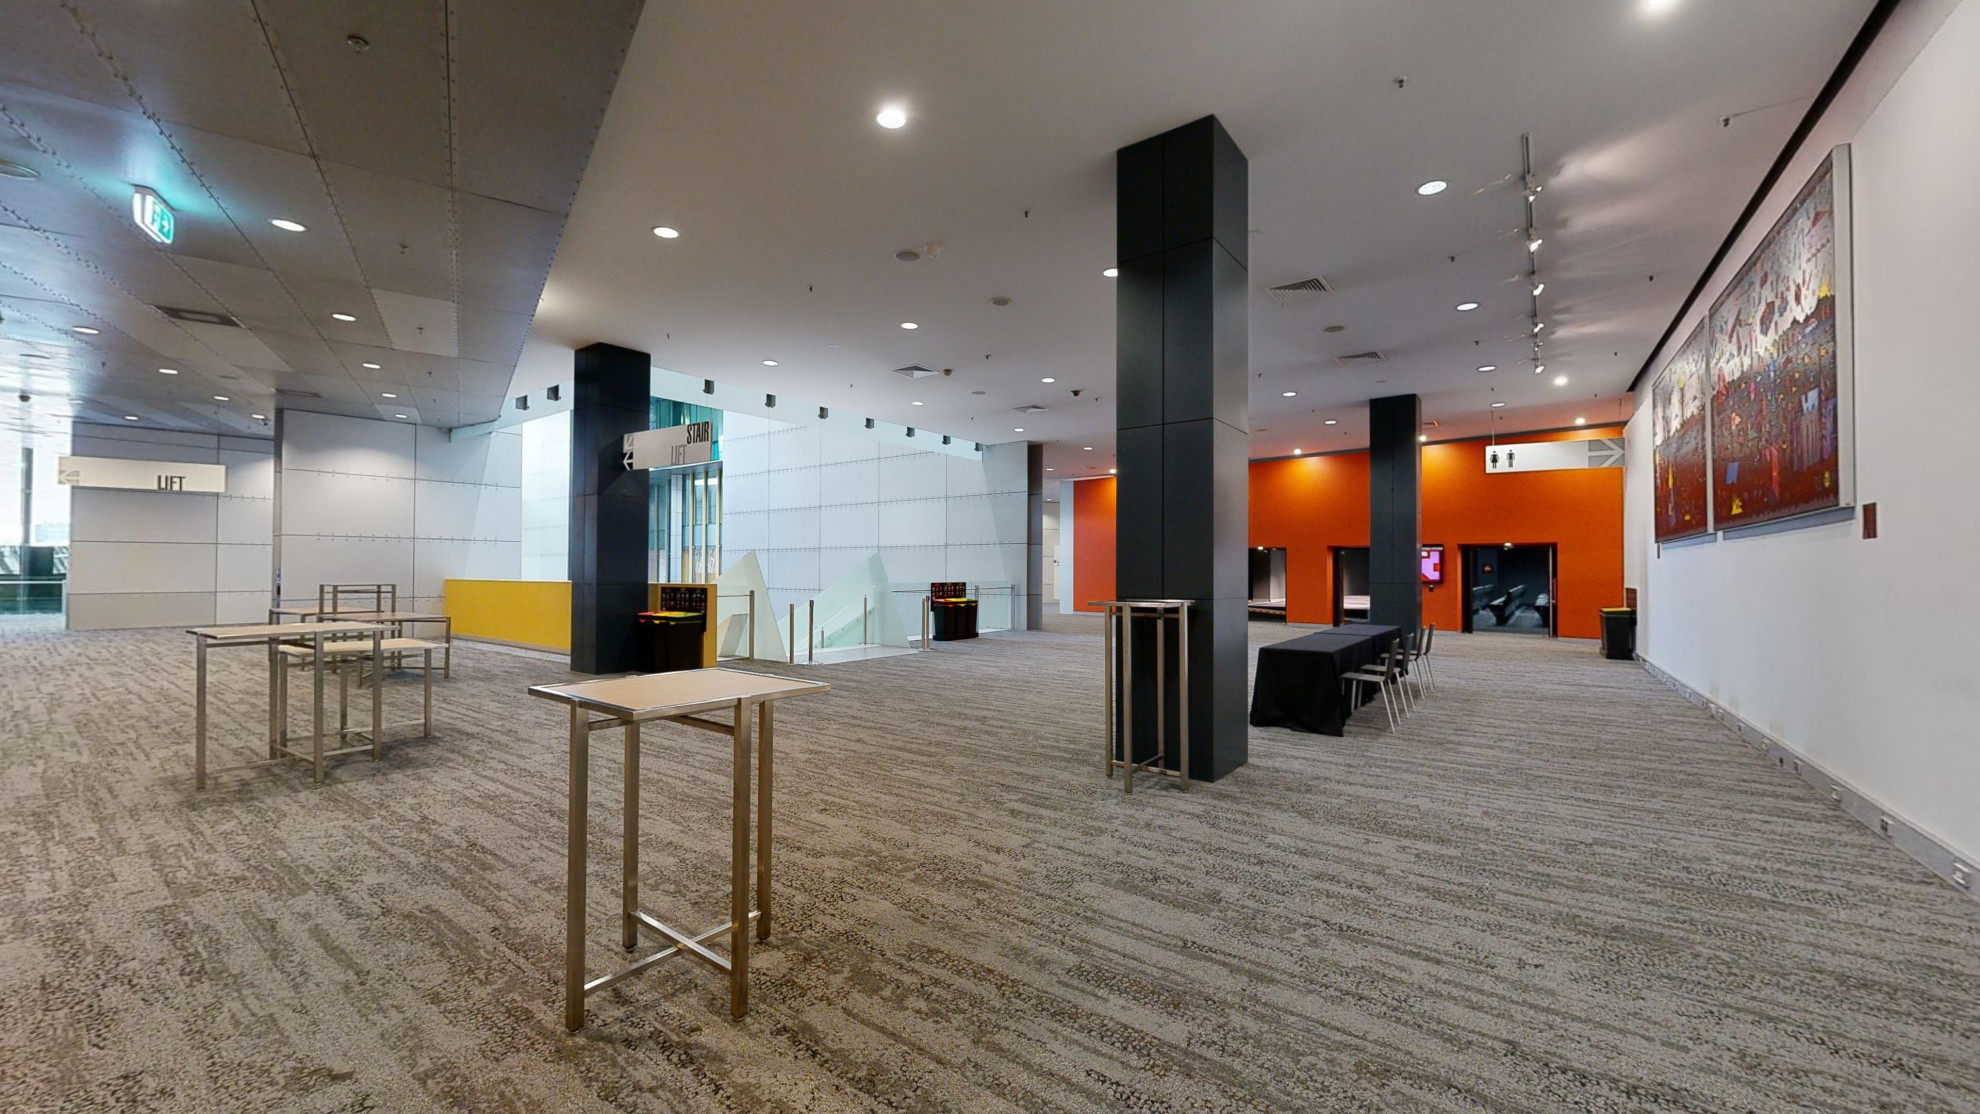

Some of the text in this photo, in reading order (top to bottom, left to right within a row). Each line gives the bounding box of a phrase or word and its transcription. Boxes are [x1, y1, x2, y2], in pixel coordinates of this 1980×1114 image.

[687, 421, 710, 444] STAIR
[671, 444, 687, 465] LIFT
[157, 475, 186, 492] LIFT
